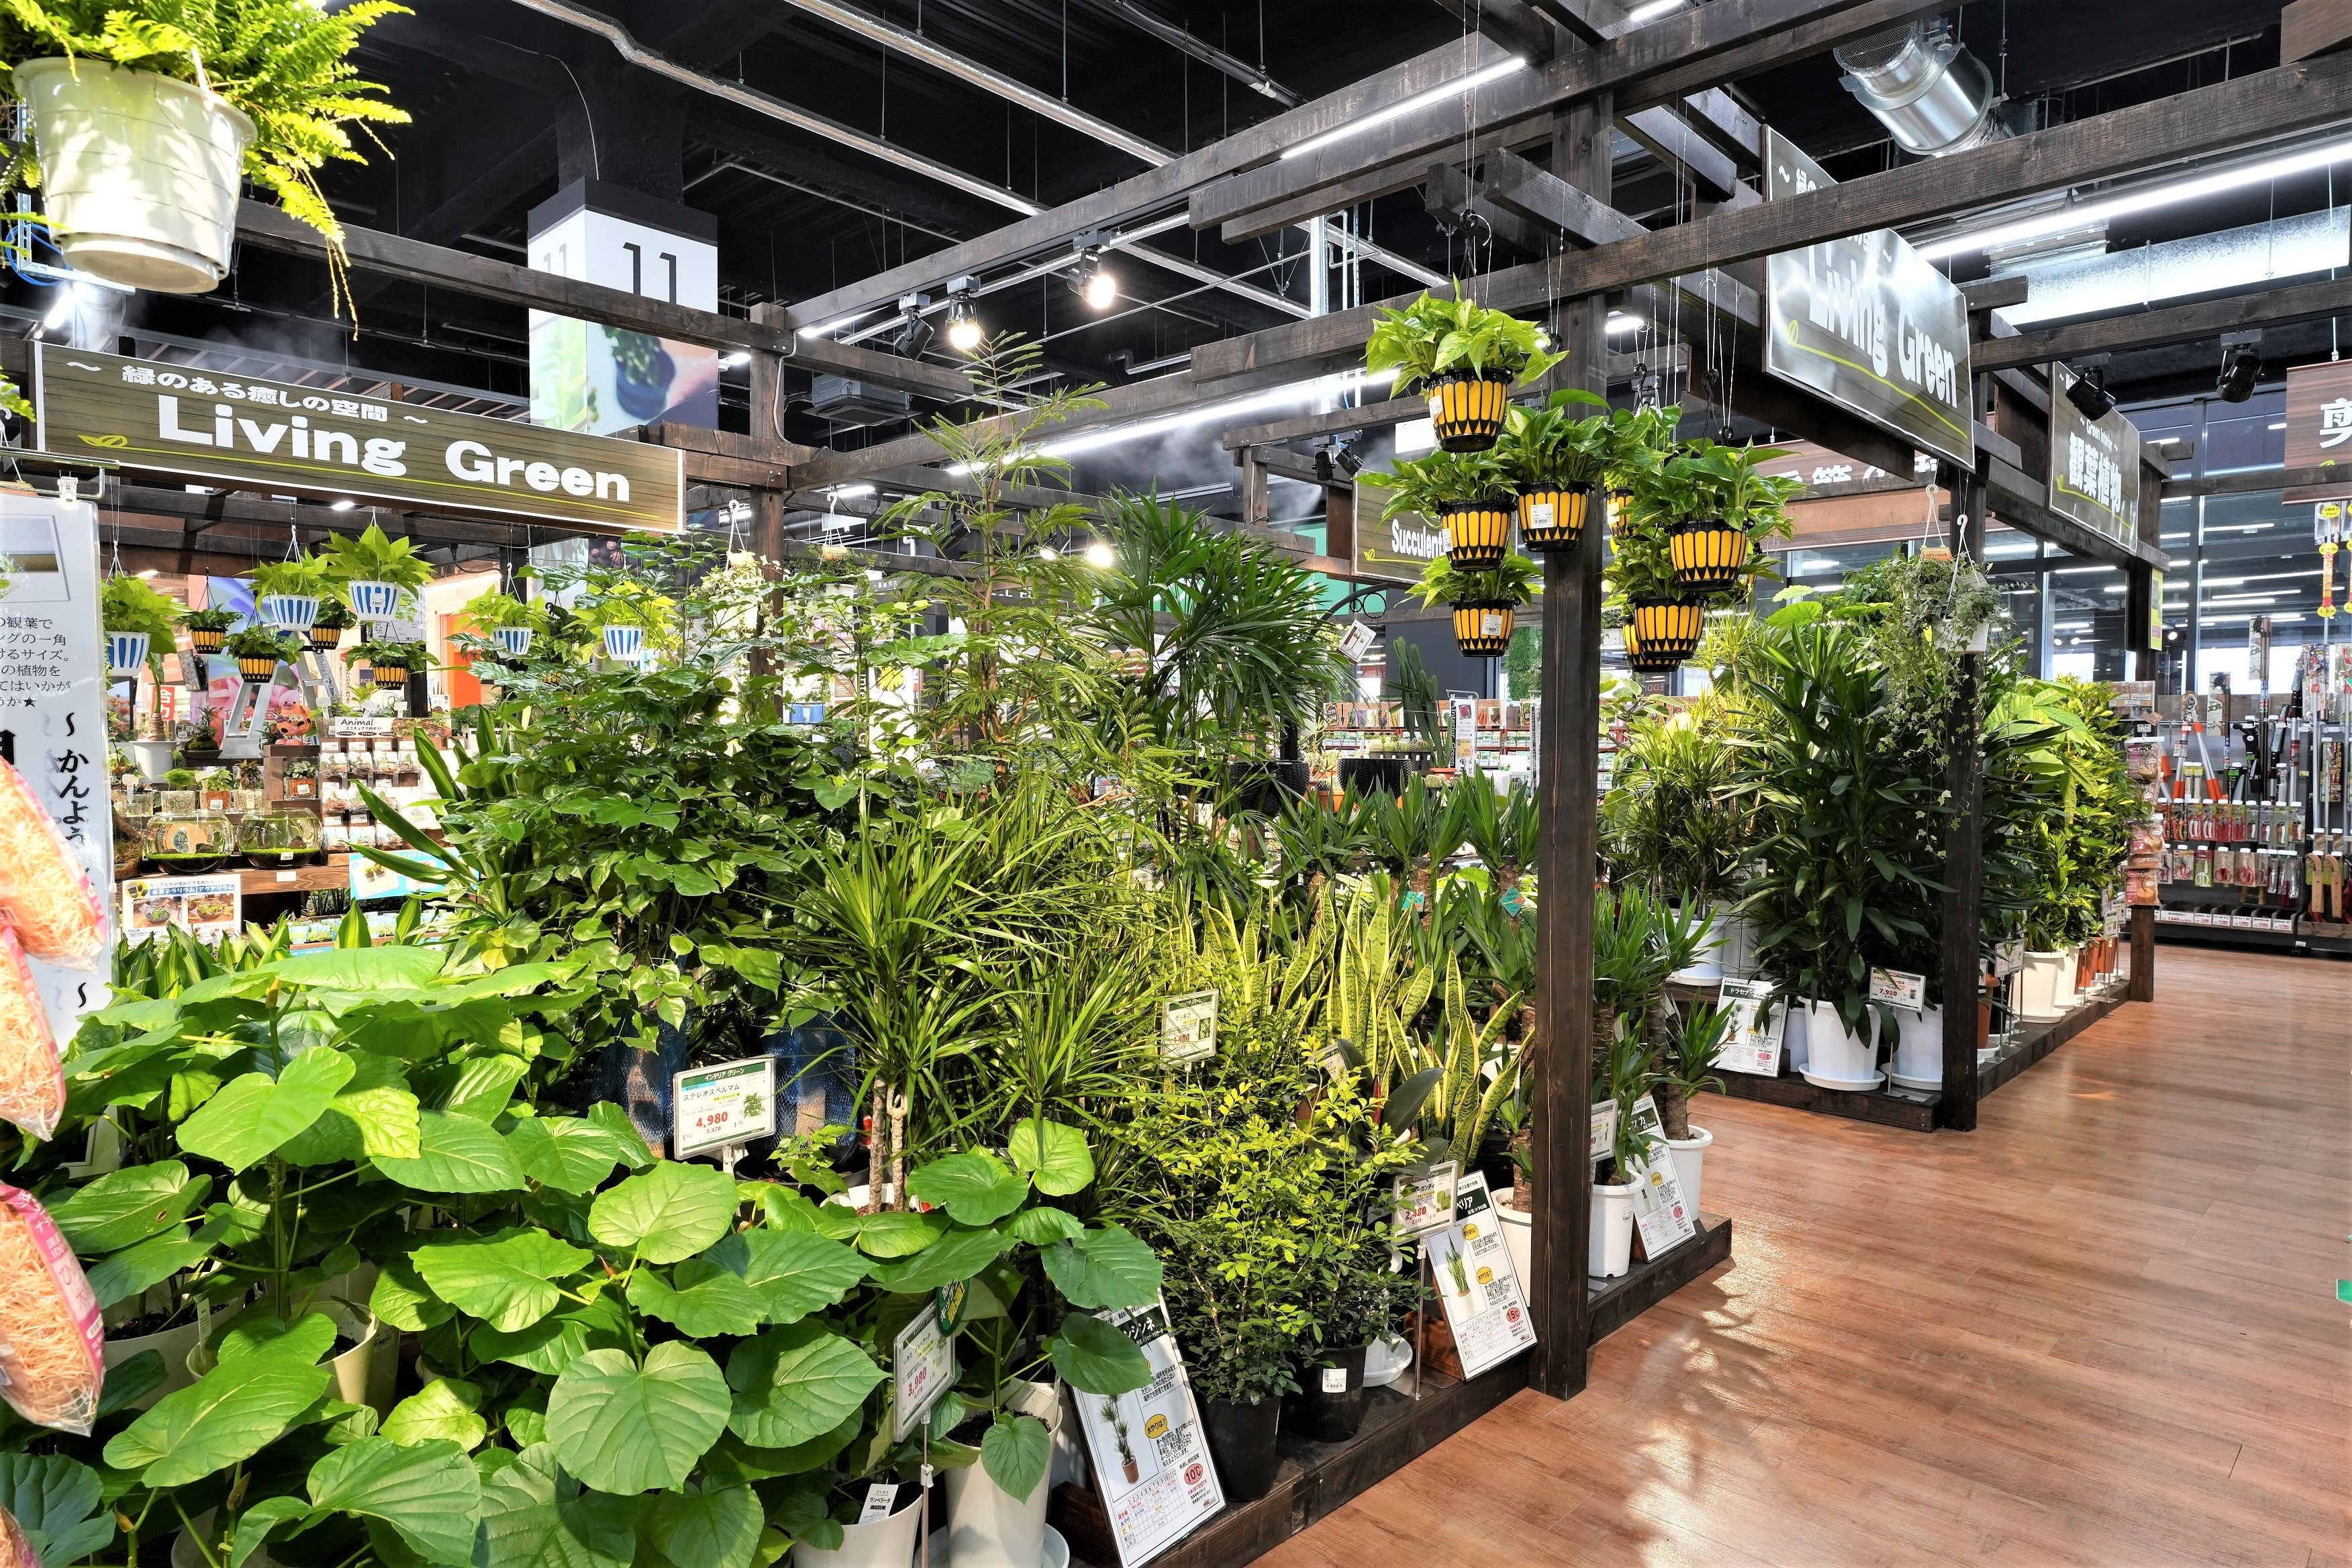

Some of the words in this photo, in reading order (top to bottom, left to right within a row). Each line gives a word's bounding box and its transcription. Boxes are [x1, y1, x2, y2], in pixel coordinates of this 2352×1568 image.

[623, 242, 677, 305] 11
[1809, 243, 1888, 378] Living
[1898, 298, 1958, 409] Green
[122, 364, 388, 423] 緑のある癒しの空間
[2086, 419, 2100, 441] Green
[158, 395, 407, 477] Living
[444, 440, 630, 503] Green
[2069, 431, 2122, 513] 観葉植物
[2, 665, 60, 677] の植物を
[705, 1072, 726, 1081] インテリア
[683, 1084, 740, 1101] ステレオスペルマム
[695, 1112, 728, 1128] 4,980
[1414, 1183, 1435, 1193] ーガンディ
[1406, 1206, 1426, 1220] 2,480
[1457, 1196, 1473, 1210] ベリア
[1124, 1317, 1155, 1340] ンシンネ
[908, 1366, 927, 1397] 3,980
